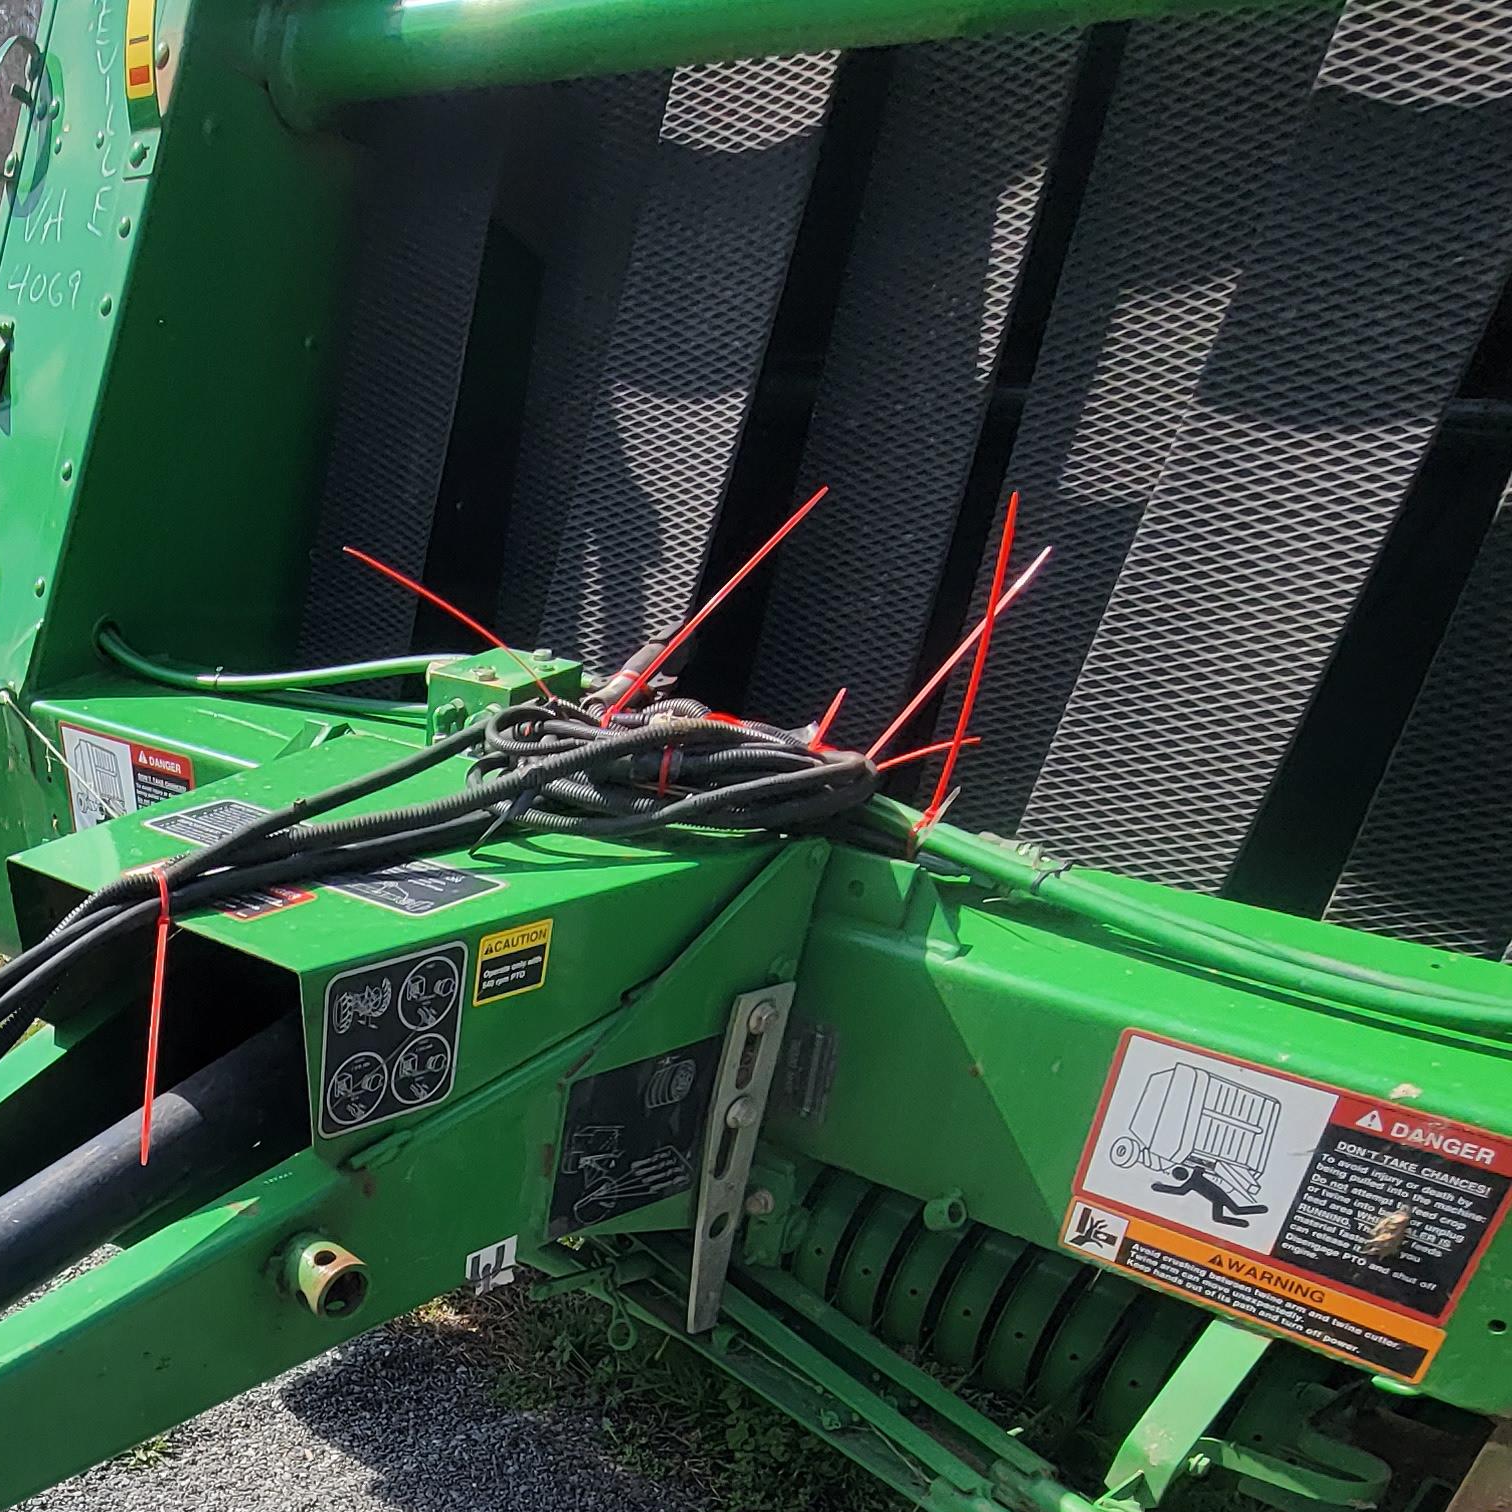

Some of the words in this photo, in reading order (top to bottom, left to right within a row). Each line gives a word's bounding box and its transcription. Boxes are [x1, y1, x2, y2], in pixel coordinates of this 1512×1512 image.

[8, 263, 82, 310] 4069
[149, 756, 182, 774] DANGER
[494, 928, 547, 953] CAUTION
[510, 970, 526, 981] PTO
[1390, 1122, 1496, 1165] DANGER
[1315, 1162, 1347, 1180] being
[1348, 1174, 1385, 1190] pulled
[1387, 1184, 1409, 1198] into
[1411, 1193, 1432, 1206] the
[1321, 1153, 1336, 1163] To
[1337, 1160, 1369, 1174] avoid
[1370, 1168, 1404, 1187] injury
[1406, 1181, 1420, 1190] or
[1421, 1186, 1455, 1202] death
[1457, 1196, 1473, 1209] by
[1336, 1141, 1380, 1161] DON'T
[1383, 1154, 1419, 1174] TAKE
[1421, 1167, 1491, 1197] CHANCES!
[1302, 1192, 1328, 1206] feed
[1328, 1203, 1353, 1215] area
[1405, 1228, 1437, 1243] ALER
[1438, 1238, 1452, 1248] IS
[1306, 1185, 1321, 1193] or
[1321, 1189, 1351, 1204] twine
[1353, 1199, 1375, 1212] into
[1409, 1219, 1423, 1227] or
[1424, 1224, 1465, 1243] unplug
[1311, 1173, 1327, 1184] Do
[1329, 1180, 1349, 1192] not
[1350, 1186, 1394, 1206] attempt
[1411, 1206, 1439, 1220] feed
[1439, 1216, 1467, 1231] crop
[1289, 1223, 1309, 1235] can
[1311, 1231, 1351, 1249] release
[1293, 1215, 1337, 1234] material
[1400, 1252, 1421, 1263] you
[1410, 1241, 1442, 1257] feeds
[1228, 1258, 1326, 1303] WARNING
[1285, 1231, 1340, 1257] Disengage
[1342, 1252, 1367, 1266] PTO
[1368, 1263, 1390, 1275] and
[1392, 1272, 1418, 1285] shut
[1419, 1281, 1437, 1291] off
[1126, 1258, 1152, 1273] Keep
[1152, 1268, 1184, 1285] hands
[1185, 1281, 1204, 1293] out
[1204, 1288, 1216, 1297] of
[1217, 1292, 1231, 1303] its
[1232, 1300, 1257, 1313] path
[1258, 1309, 1280, 1322] and
[1280, 1317, 1304, 1331] turn
[1305, 1327, 1323, 1338] off
[1322, 1334, 1361, 1354] power.
[1130, 1250, 1159, 1267] Twine
[1159, 1263, 1180, 1275] arm
[1181, 1271, 1200, 1283] can
[1201, 1279, 1230, 1294] move
[1231, 1290, 1305, 1323] unexpectedly.
[1131, 1243, 1161, 1259] Avoid
[1162, 1255, 1207, 1278] crushing
[1208, 1271, 1252, 1293] between
[1254, 1288, 1284, 1305] twine
[1284, 1300, 1307, 1314] arm
[1308, 1310, 1330, 1323] and
[1331, 1318, 1363, 1335] twine
[1364, 1331, 1402, 1351] cutter.
